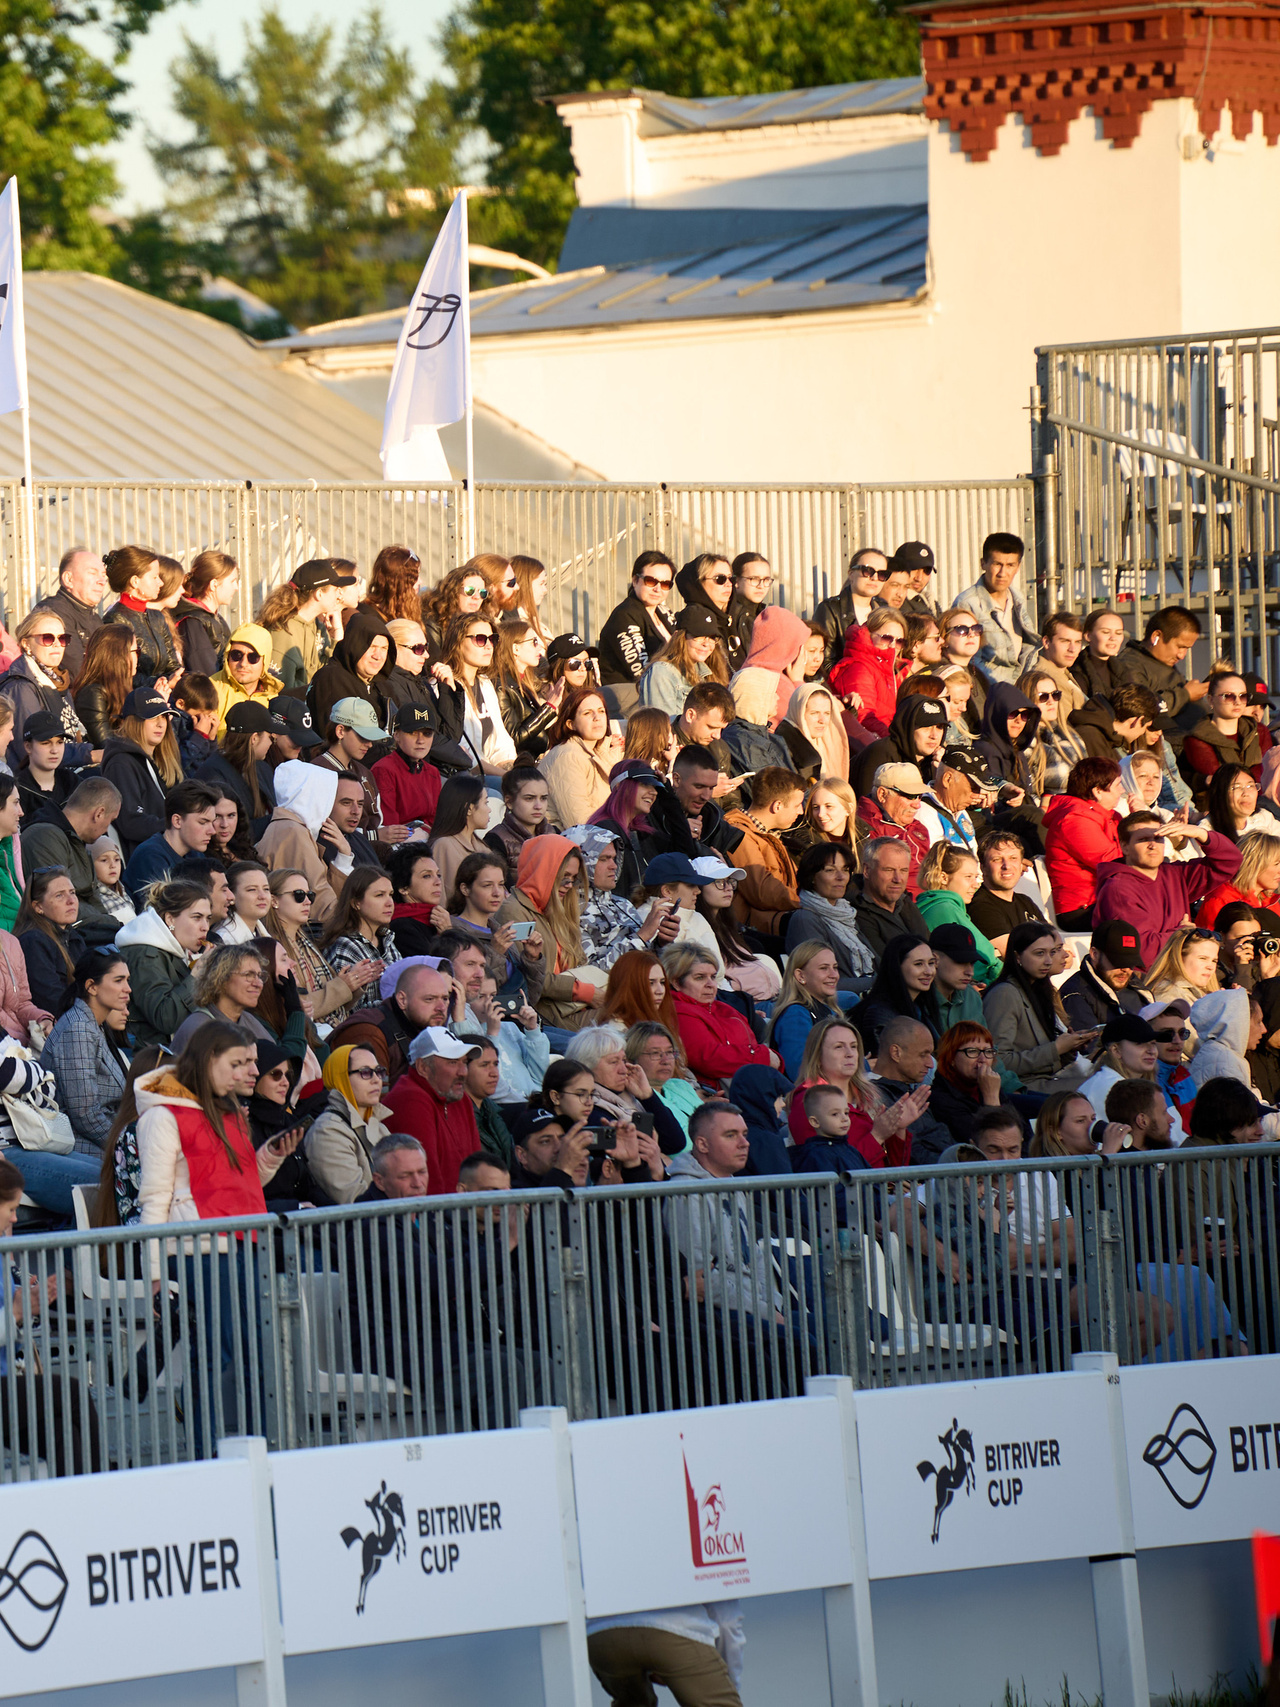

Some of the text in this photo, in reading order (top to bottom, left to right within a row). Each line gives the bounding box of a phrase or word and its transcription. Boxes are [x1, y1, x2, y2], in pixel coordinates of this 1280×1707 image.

[984, 1439, 1061, 1473] BITRIVER
[987, 1477, 1023, 1508] CUP
[418, 1501, 502, 1538] BITRIVER
[420, 1543, 460, 1575] CUP
[704, 1531, 745, 1557] ФКСМ
[87, 1538, 241, 1607] BITRIVER
